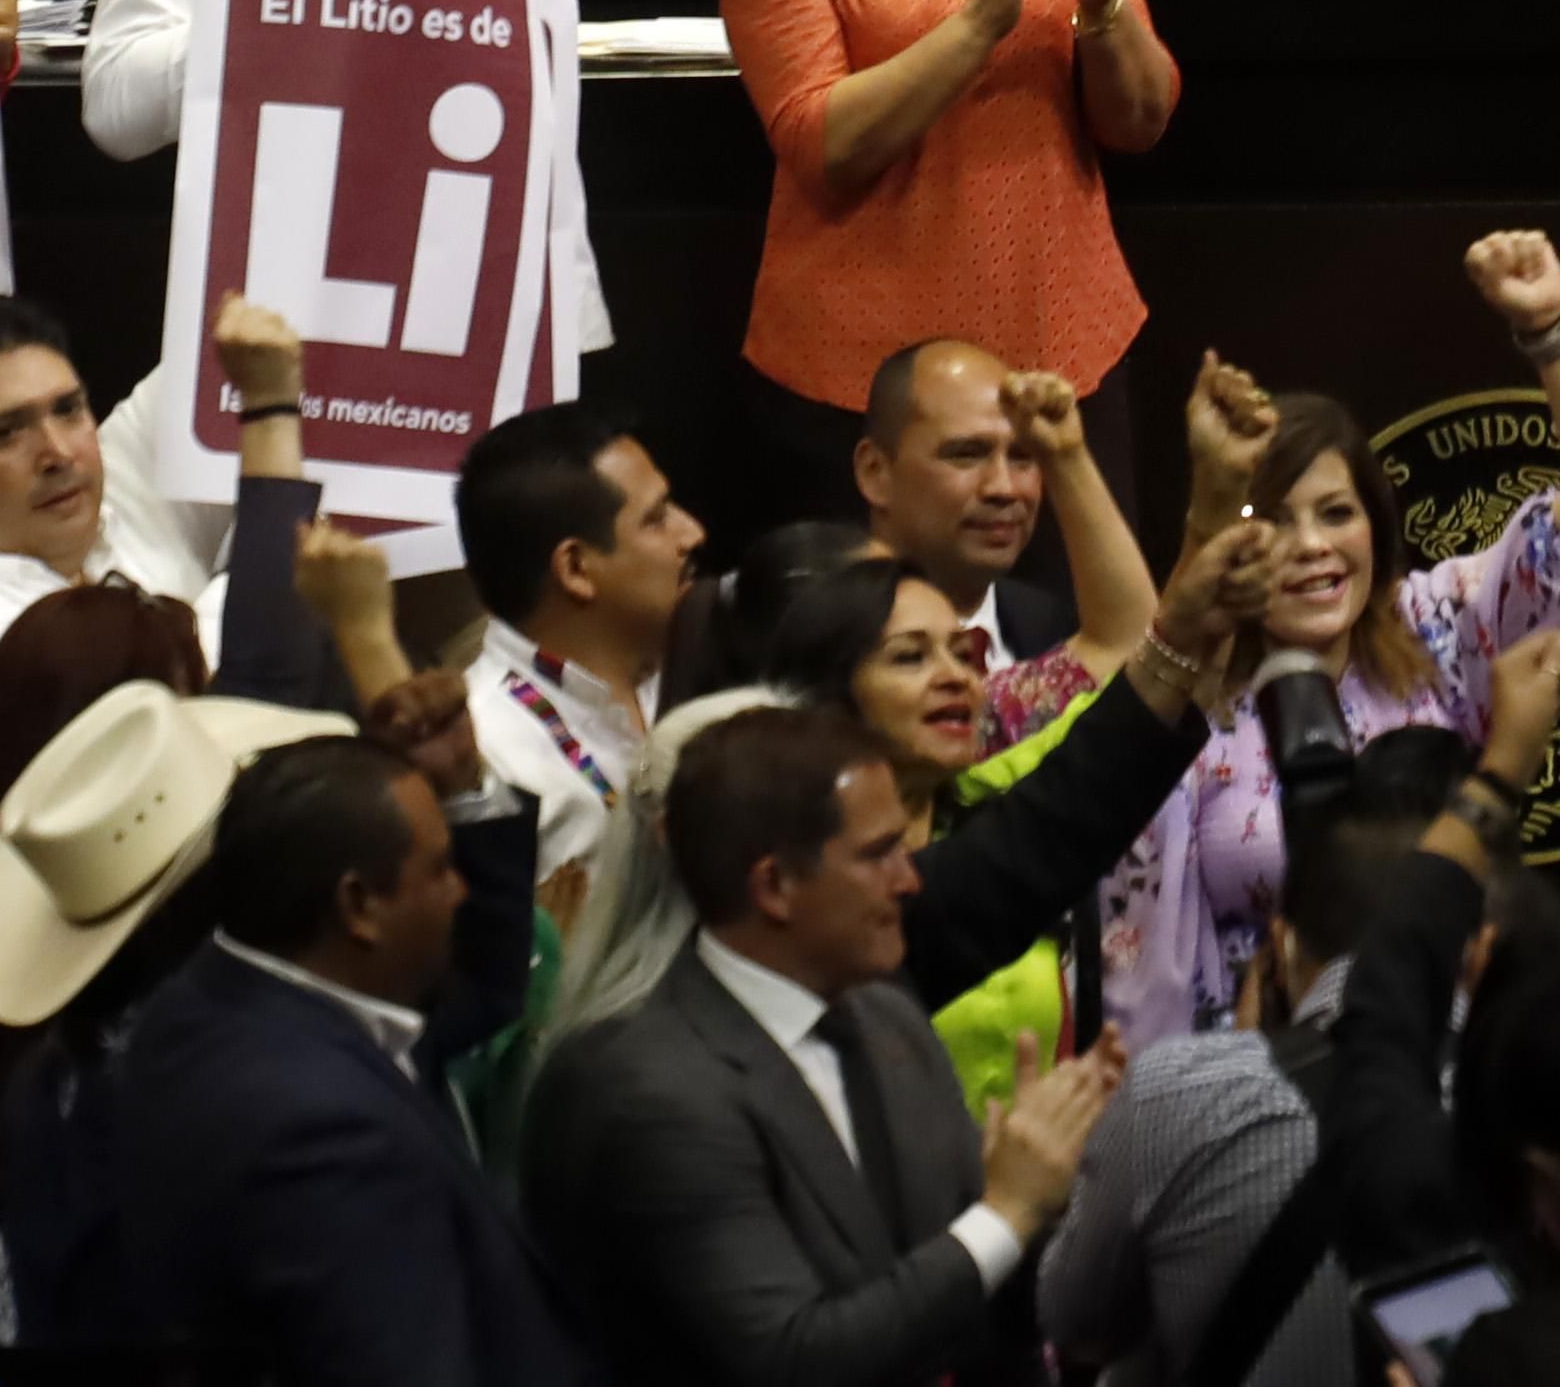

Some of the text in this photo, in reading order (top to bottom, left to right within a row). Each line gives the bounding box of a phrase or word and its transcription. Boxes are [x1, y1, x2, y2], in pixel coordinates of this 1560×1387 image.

[422, 7, 464, 41] es
[469, 5, 513, 48] de
[244, 81, 506, 358] Li
[326, 394, 473, 436] mexicanos
